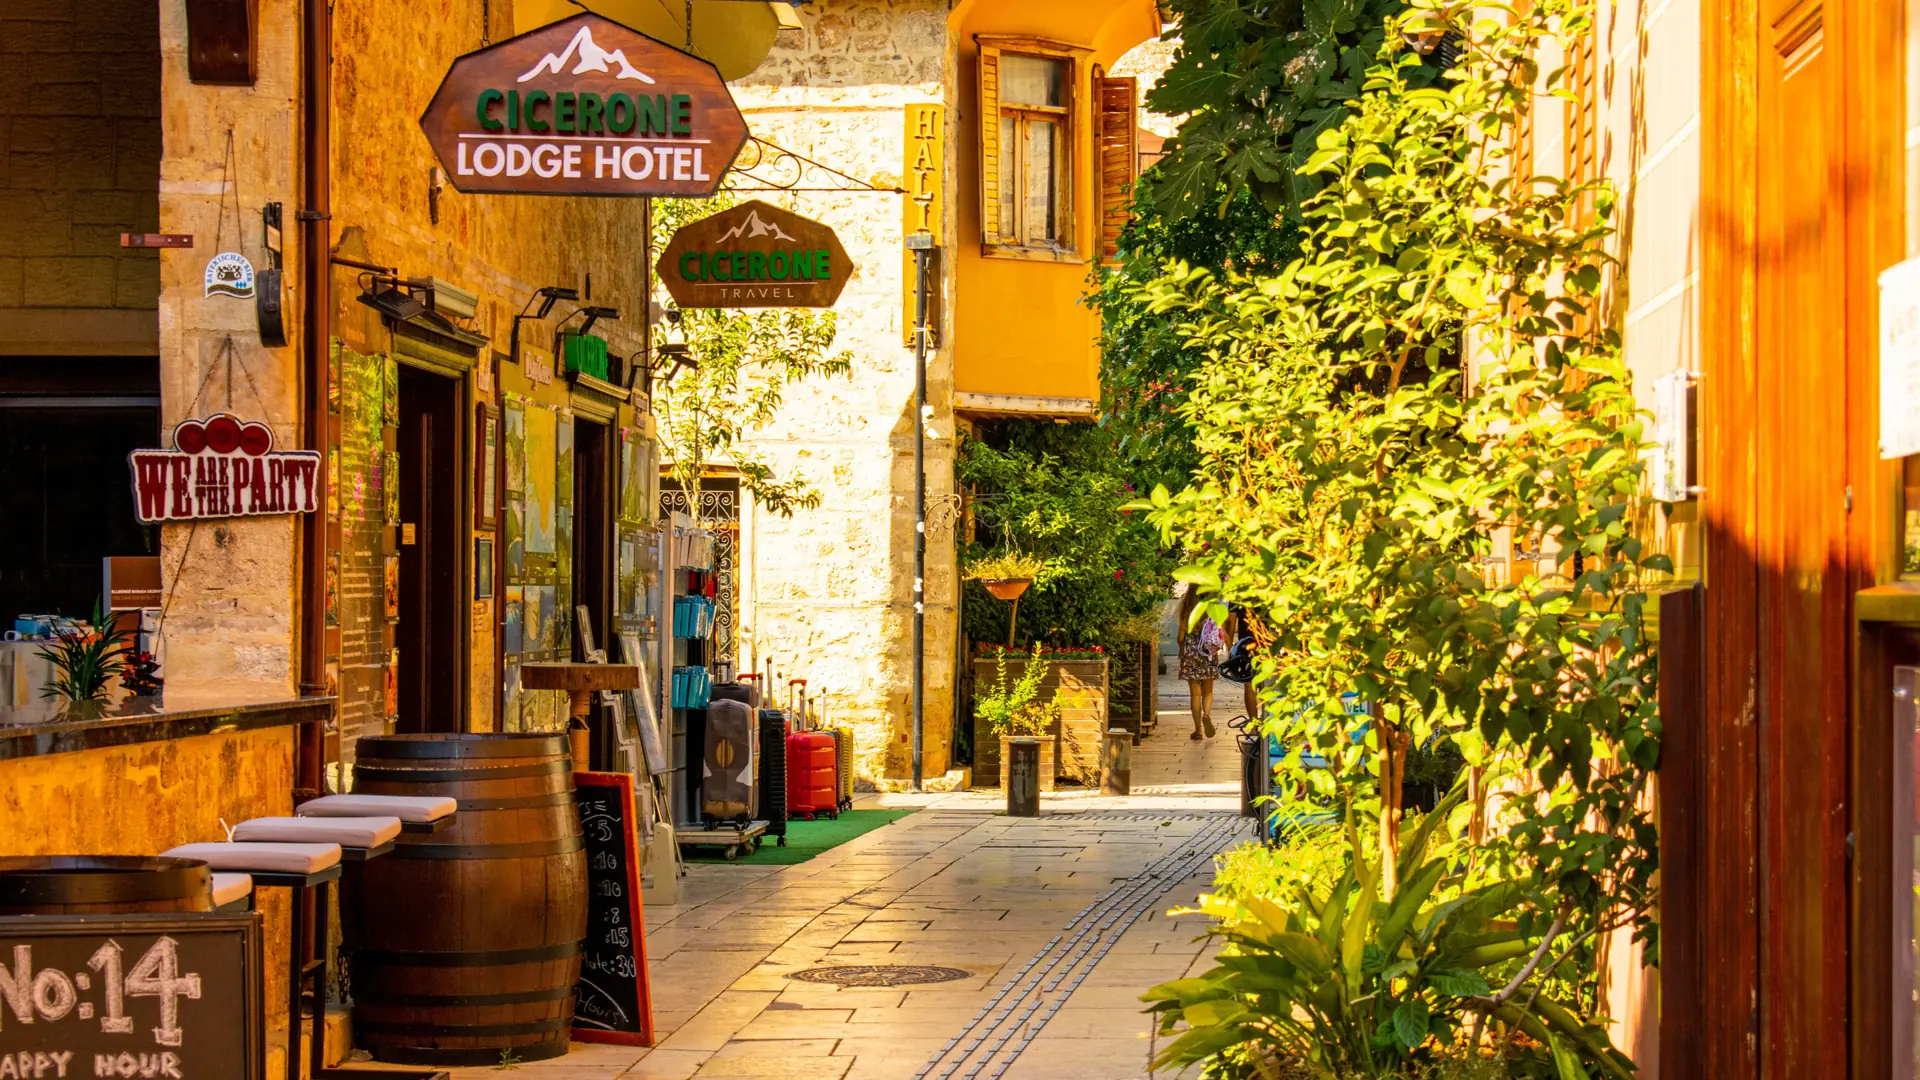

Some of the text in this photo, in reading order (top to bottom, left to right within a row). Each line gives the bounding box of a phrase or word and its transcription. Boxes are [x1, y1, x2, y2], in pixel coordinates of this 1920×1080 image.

[476, 88, 692, 135] CICERONE
[457, 142, 711, 182] LODGE HOTEL
[912, 107, 937, 232] HALI
[679, 250, 832, 282] CICERONE
[720, 287, 796, 299] TRAVEL
[134, 455, 193, 520] WE
[195, 456, 230, 486] ARE
[231, 457, 317, 514] PARTY
[195, 486, 230, 515] THE
[0, 1051, 184, 1080] APPY HOUR
